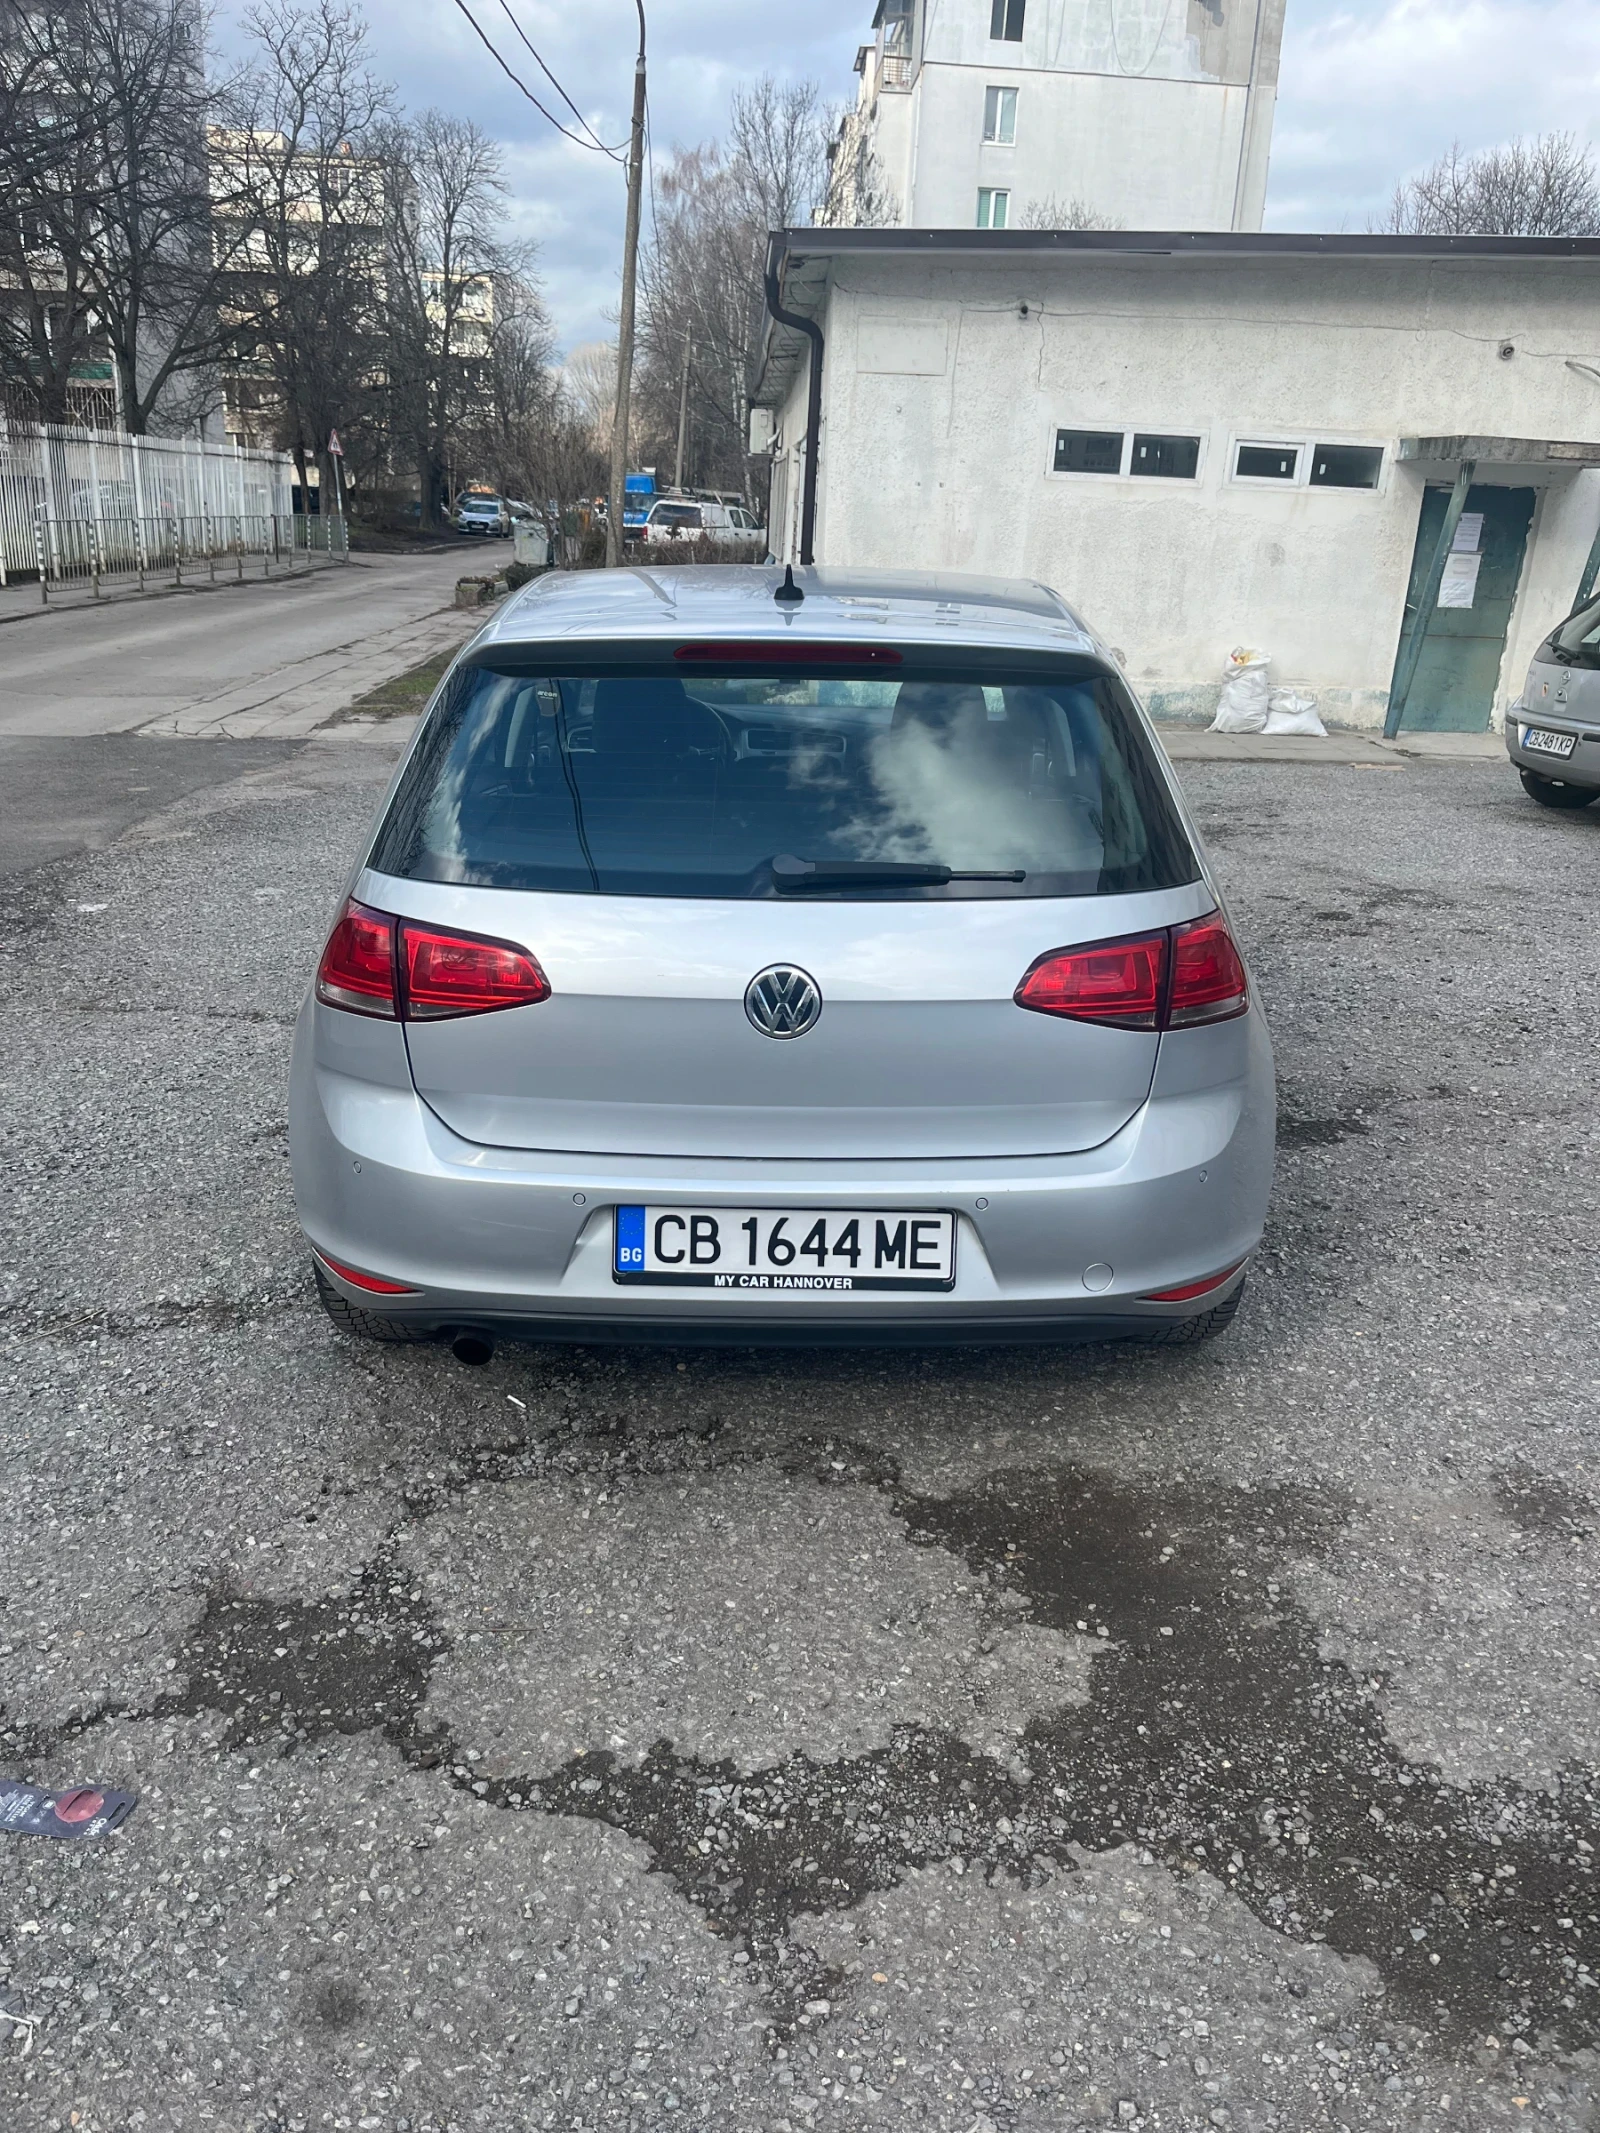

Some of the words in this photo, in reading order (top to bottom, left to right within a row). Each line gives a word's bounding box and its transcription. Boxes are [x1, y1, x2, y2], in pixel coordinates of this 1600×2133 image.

[654, 1214, 721, 1264] CB
[741, 1216, 861, 1267] 1644
[874, 1219, 941, 1270] ME
[620, 1247, 642, 1262] BG
[714, 1275, 735, 1287] MY
[739, 1276, 769, 1288] CAR
[773, 1276, 853, 1289] HANNOVER
